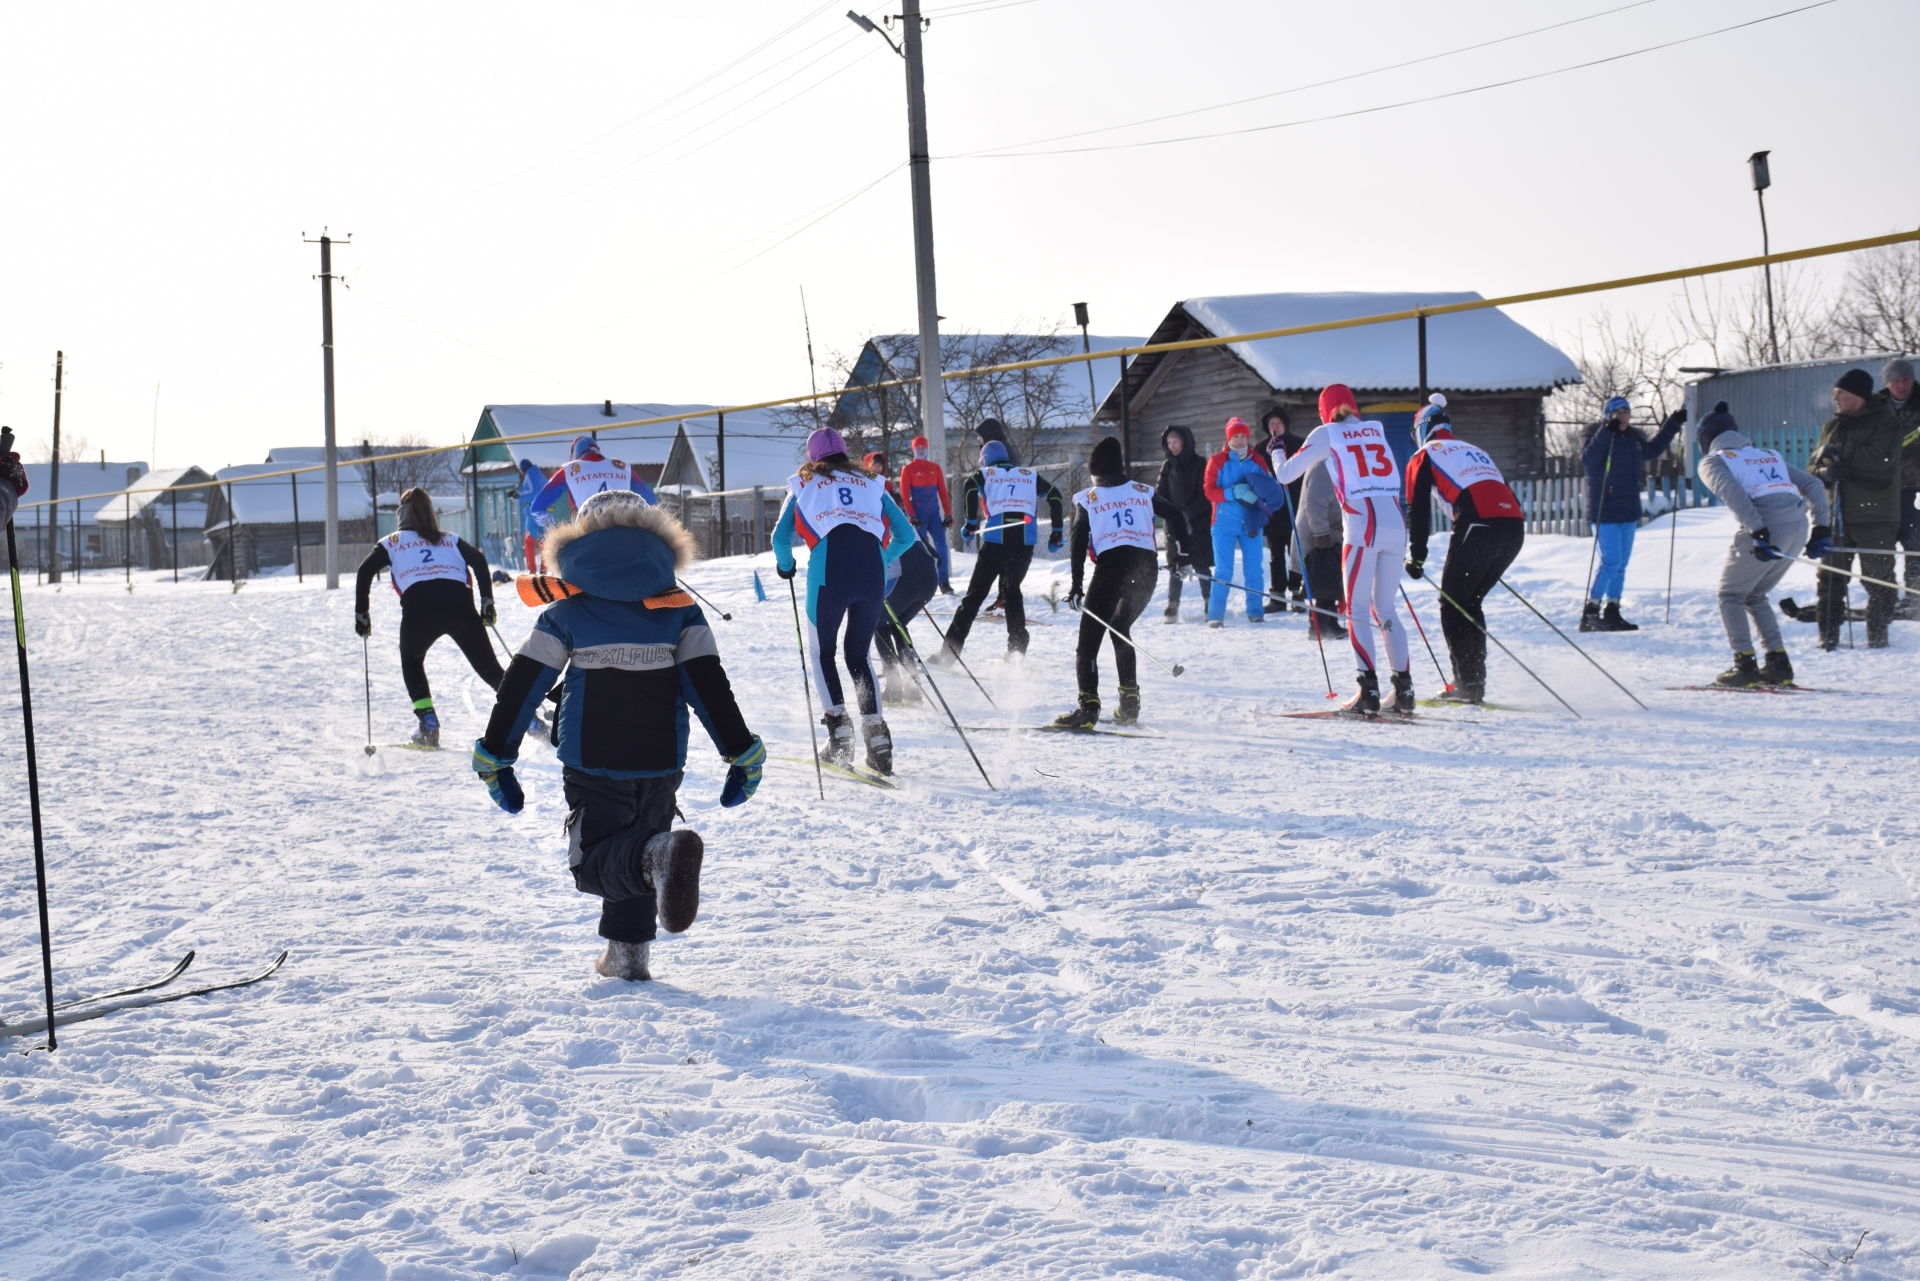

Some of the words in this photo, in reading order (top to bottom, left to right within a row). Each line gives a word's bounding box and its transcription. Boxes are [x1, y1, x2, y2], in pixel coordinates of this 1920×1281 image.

[1343, 427, 1381, 439] НАСТЯ
[1346, 444, 1393, 478] 13
[575, 472, 627, 484] ТАТАРСТАН
[1759, 466, 1783, 481] 14
[817, 476, 867, 488] РОССИЯ
[838, 487, 854, 505] 8
[1007, 484, 1016, 497] 7
[1093, 498, 1149, 514] ТАТАРСТАН
[1112, 508, 1135, 529] 15
[419, 549, 435, 563] 2
